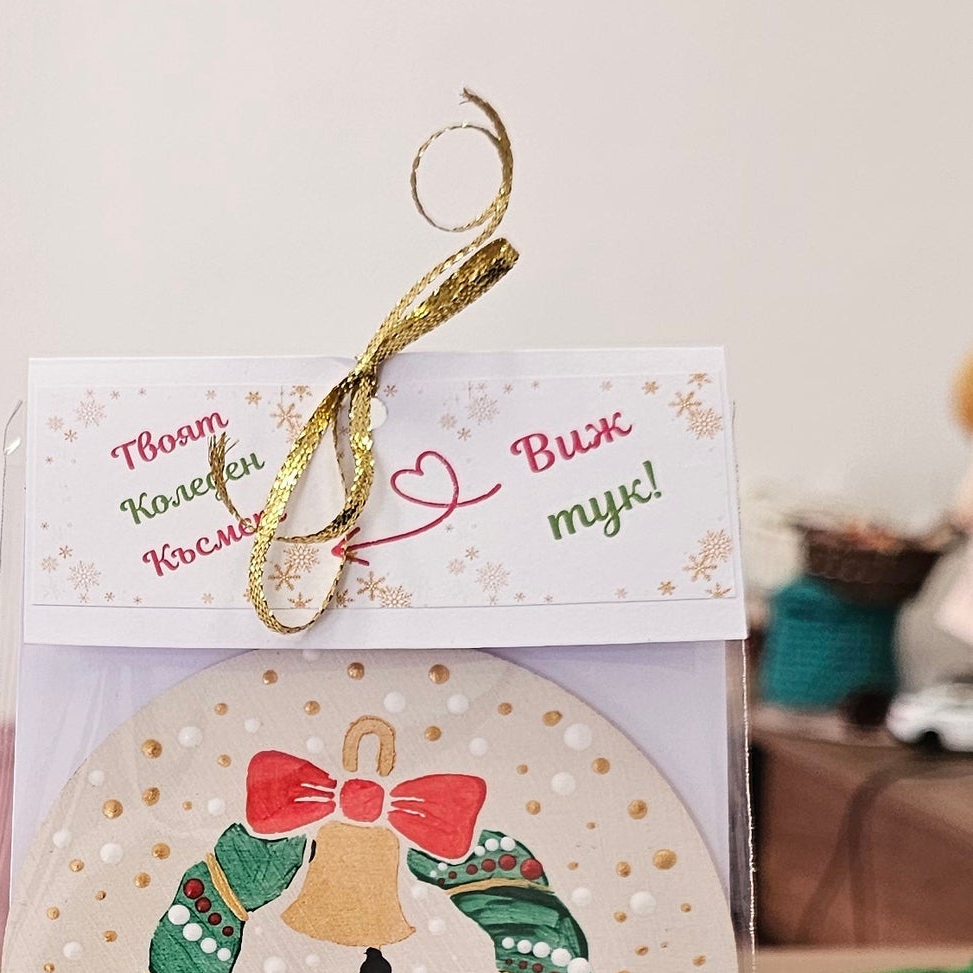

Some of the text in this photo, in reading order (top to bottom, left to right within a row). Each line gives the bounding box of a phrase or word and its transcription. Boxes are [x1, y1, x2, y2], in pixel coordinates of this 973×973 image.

[110, 411, 230, 471] Твоят
[510, 411, 633, 474] Виж
[547, 459, 664, 540] тук!
[141, 509, 288, 577] Късме
